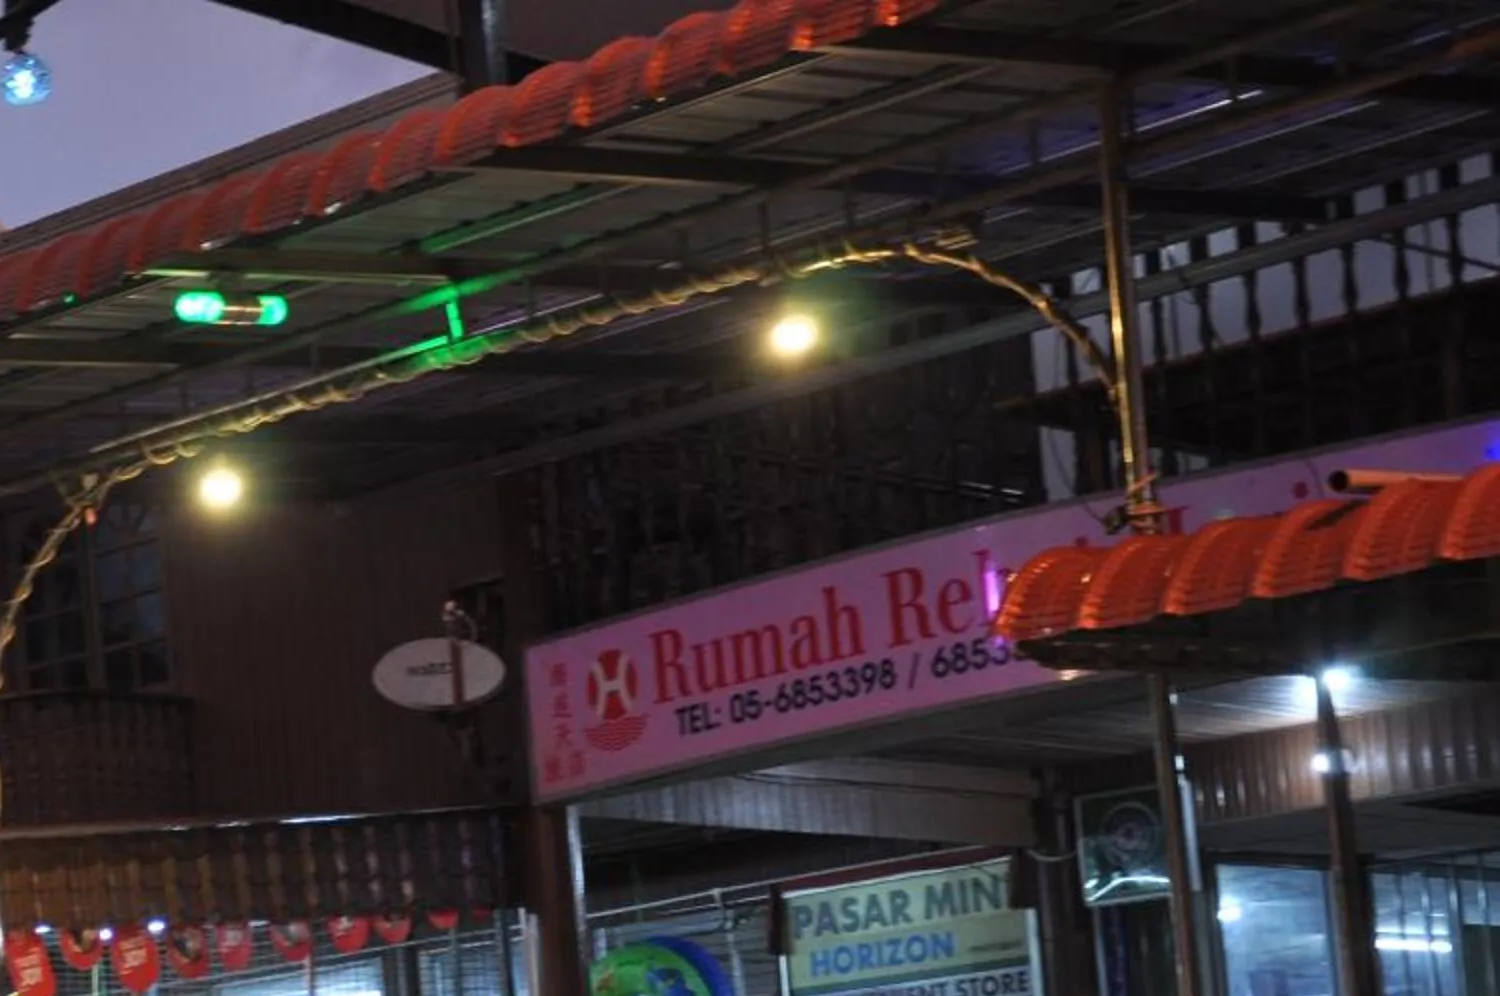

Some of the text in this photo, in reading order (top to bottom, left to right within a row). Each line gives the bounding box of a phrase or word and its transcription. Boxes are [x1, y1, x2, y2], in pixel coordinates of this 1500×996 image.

[648, 587, 865, 704] Rumah
[676, 703, 722, 737] TEL:
[731, 653, 897, 724] 05-6853398
[793, 873, 1002, 940] PASAR MIN
[810, 932, 957, 978] HORIZON
